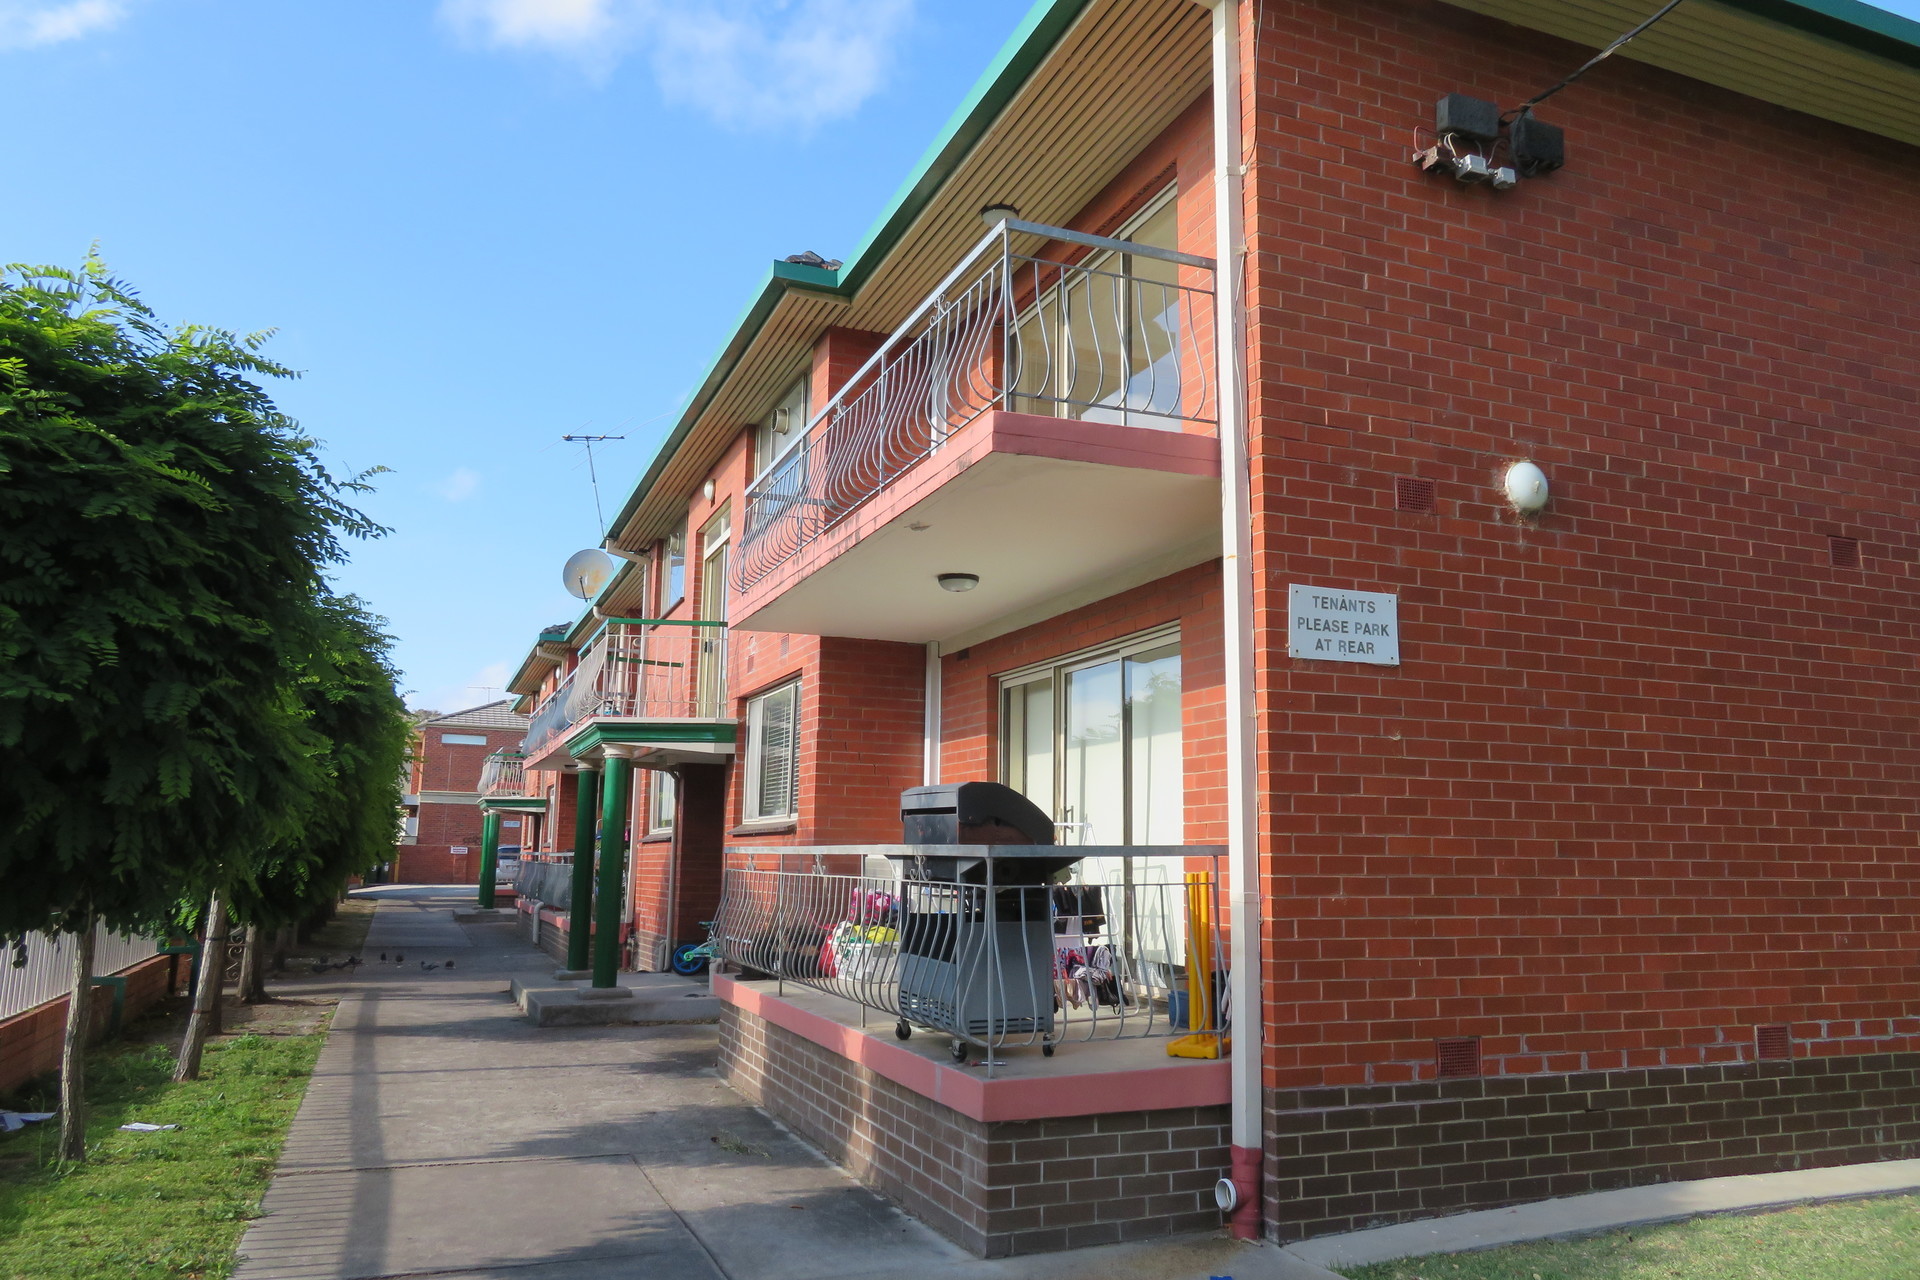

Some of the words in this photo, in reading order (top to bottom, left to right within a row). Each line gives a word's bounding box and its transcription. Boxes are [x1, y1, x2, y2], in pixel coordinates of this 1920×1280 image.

[1312, 596, 1376, 613] TENANTS
[1297, 617, 1349, 633] PLEASE
[1354, 622, 1390, 636] PARK
[1315, 638, 1332, 651] AT
[1338, 640, 1375, 654] REAR
